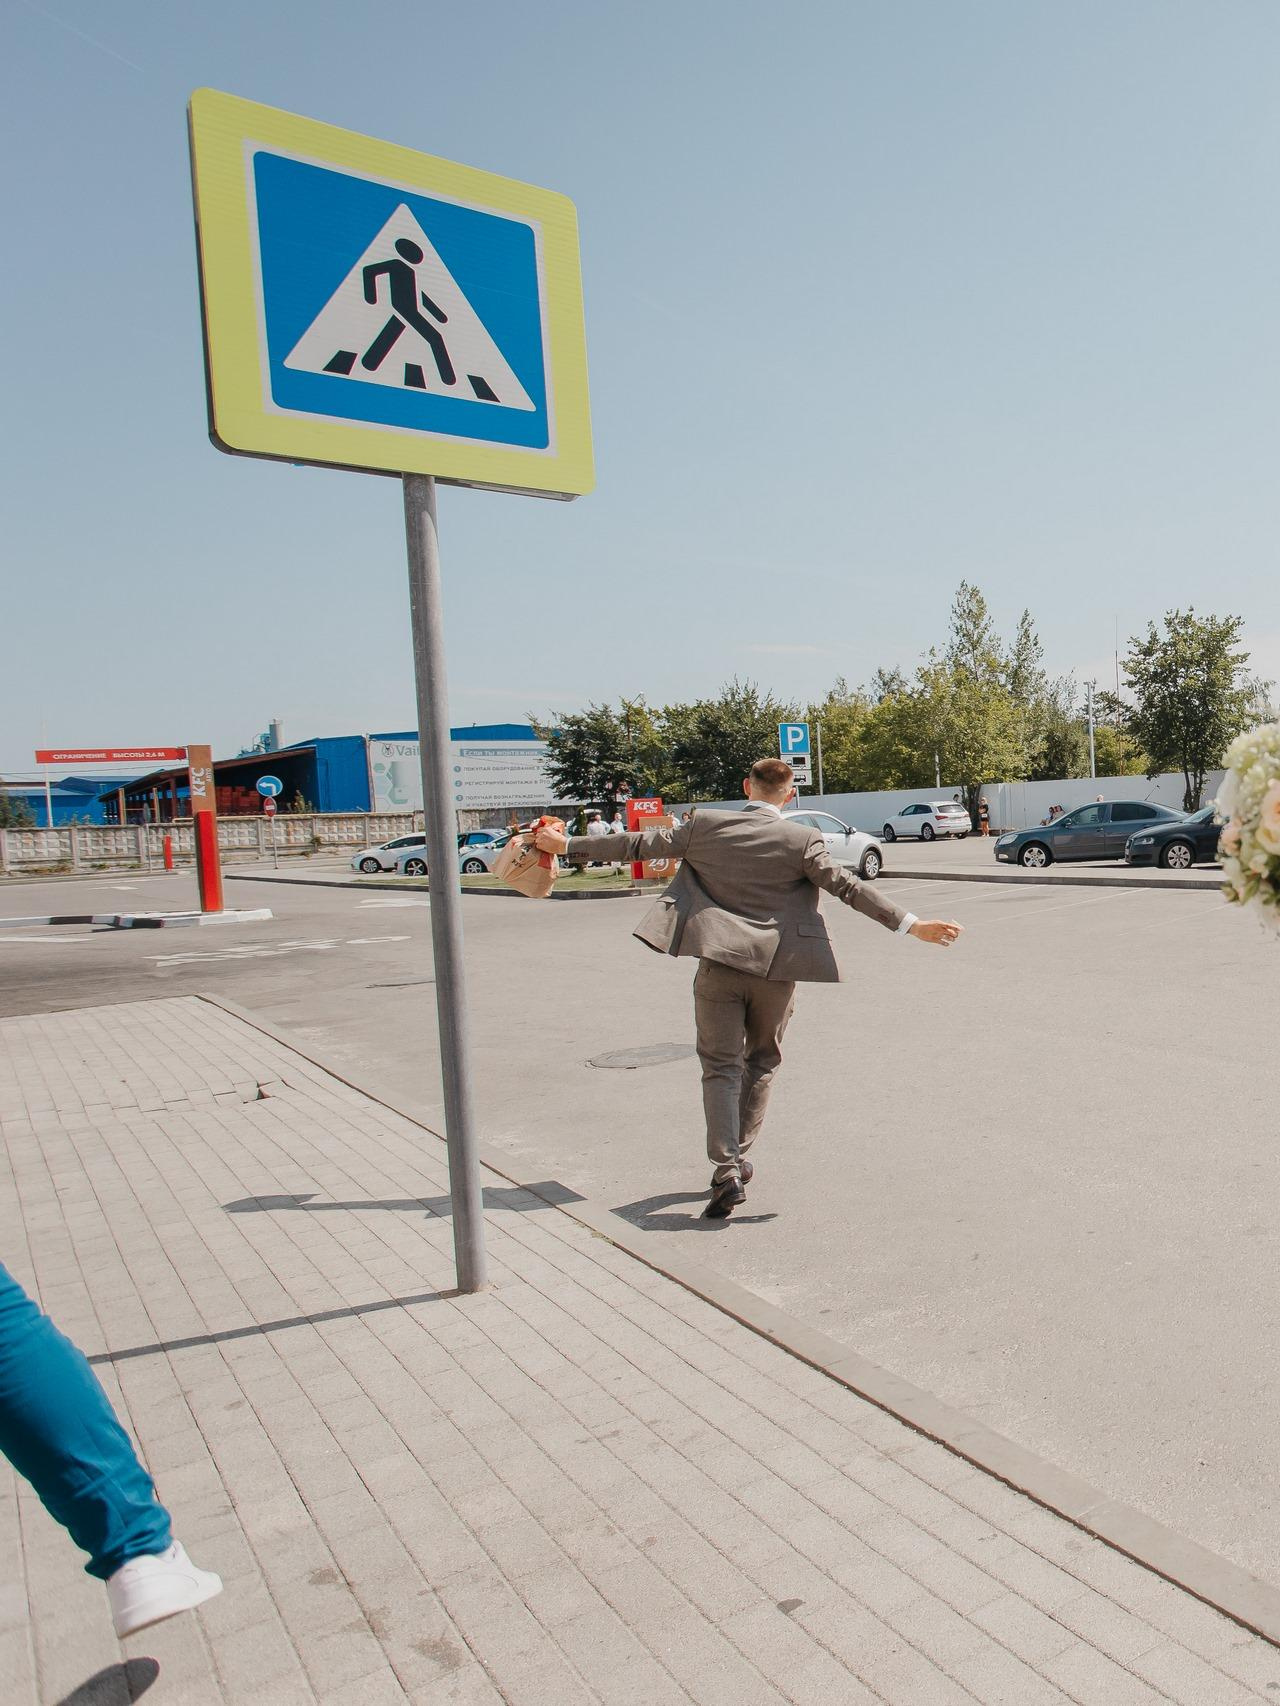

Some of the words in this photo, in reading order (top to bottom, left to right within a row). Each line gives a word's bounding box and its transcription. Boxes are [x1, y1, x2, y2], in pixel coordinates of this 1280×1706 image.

[787, 726, 804, 751] P
[192, 767, 206, 796] KFC
[633, 801, 658, 811] KFC
